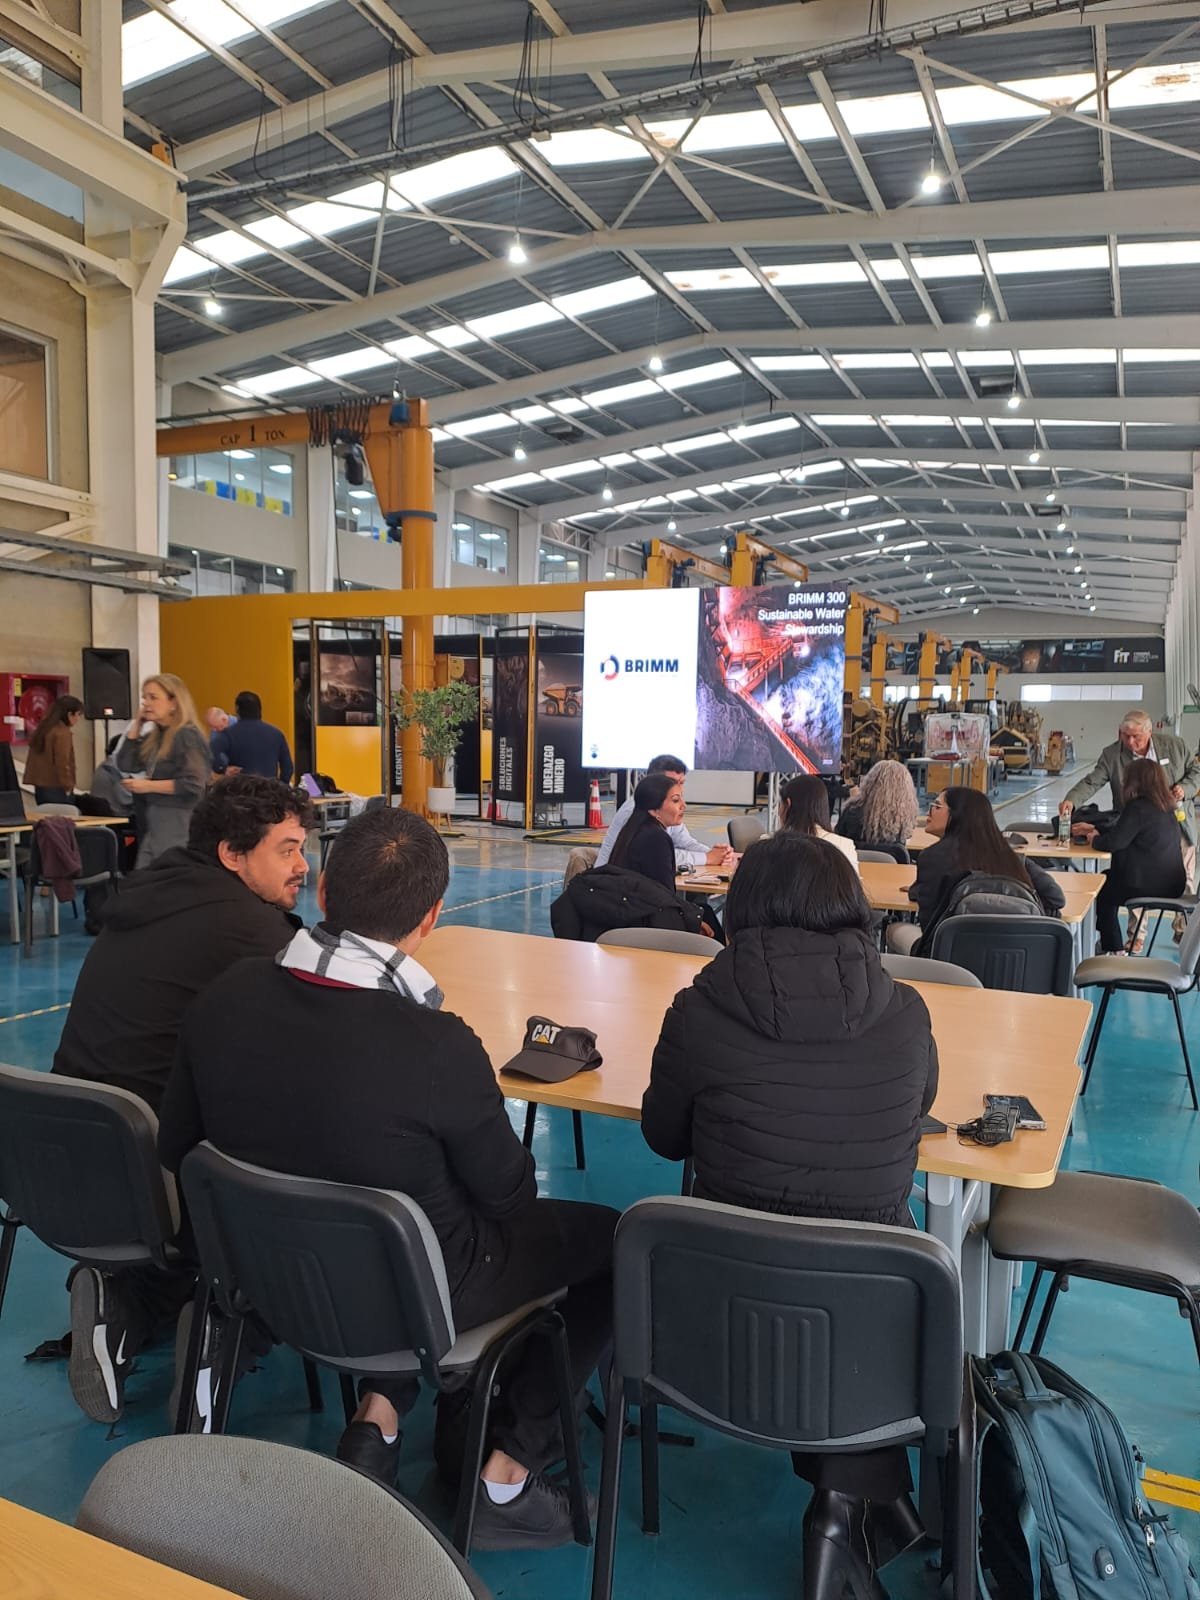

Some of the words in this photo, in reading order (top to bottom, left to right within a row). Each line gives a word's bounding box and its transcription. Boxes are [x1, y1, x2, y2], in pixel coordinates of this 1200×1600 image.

[250, 424, 256, 442] 1
[788, 593, 825, 605] BRIMM
[826, 591, 846, 604] 300
[758, 608, 813, 620] Sustainable
[815, 607, 846, 619] Water
[785, 623, 845, 636] Stewardship
[624, 659, 679, 673] BRIMM
[499, 736, 507, 791] SOLUCIONES
[505, 746, 513, 791] DIGITALES
[542, 744, 555, 794] LIDERAZGO
[553, 757, 565, 794] MINERO
[531, 1023, 562, 1045] CAT
